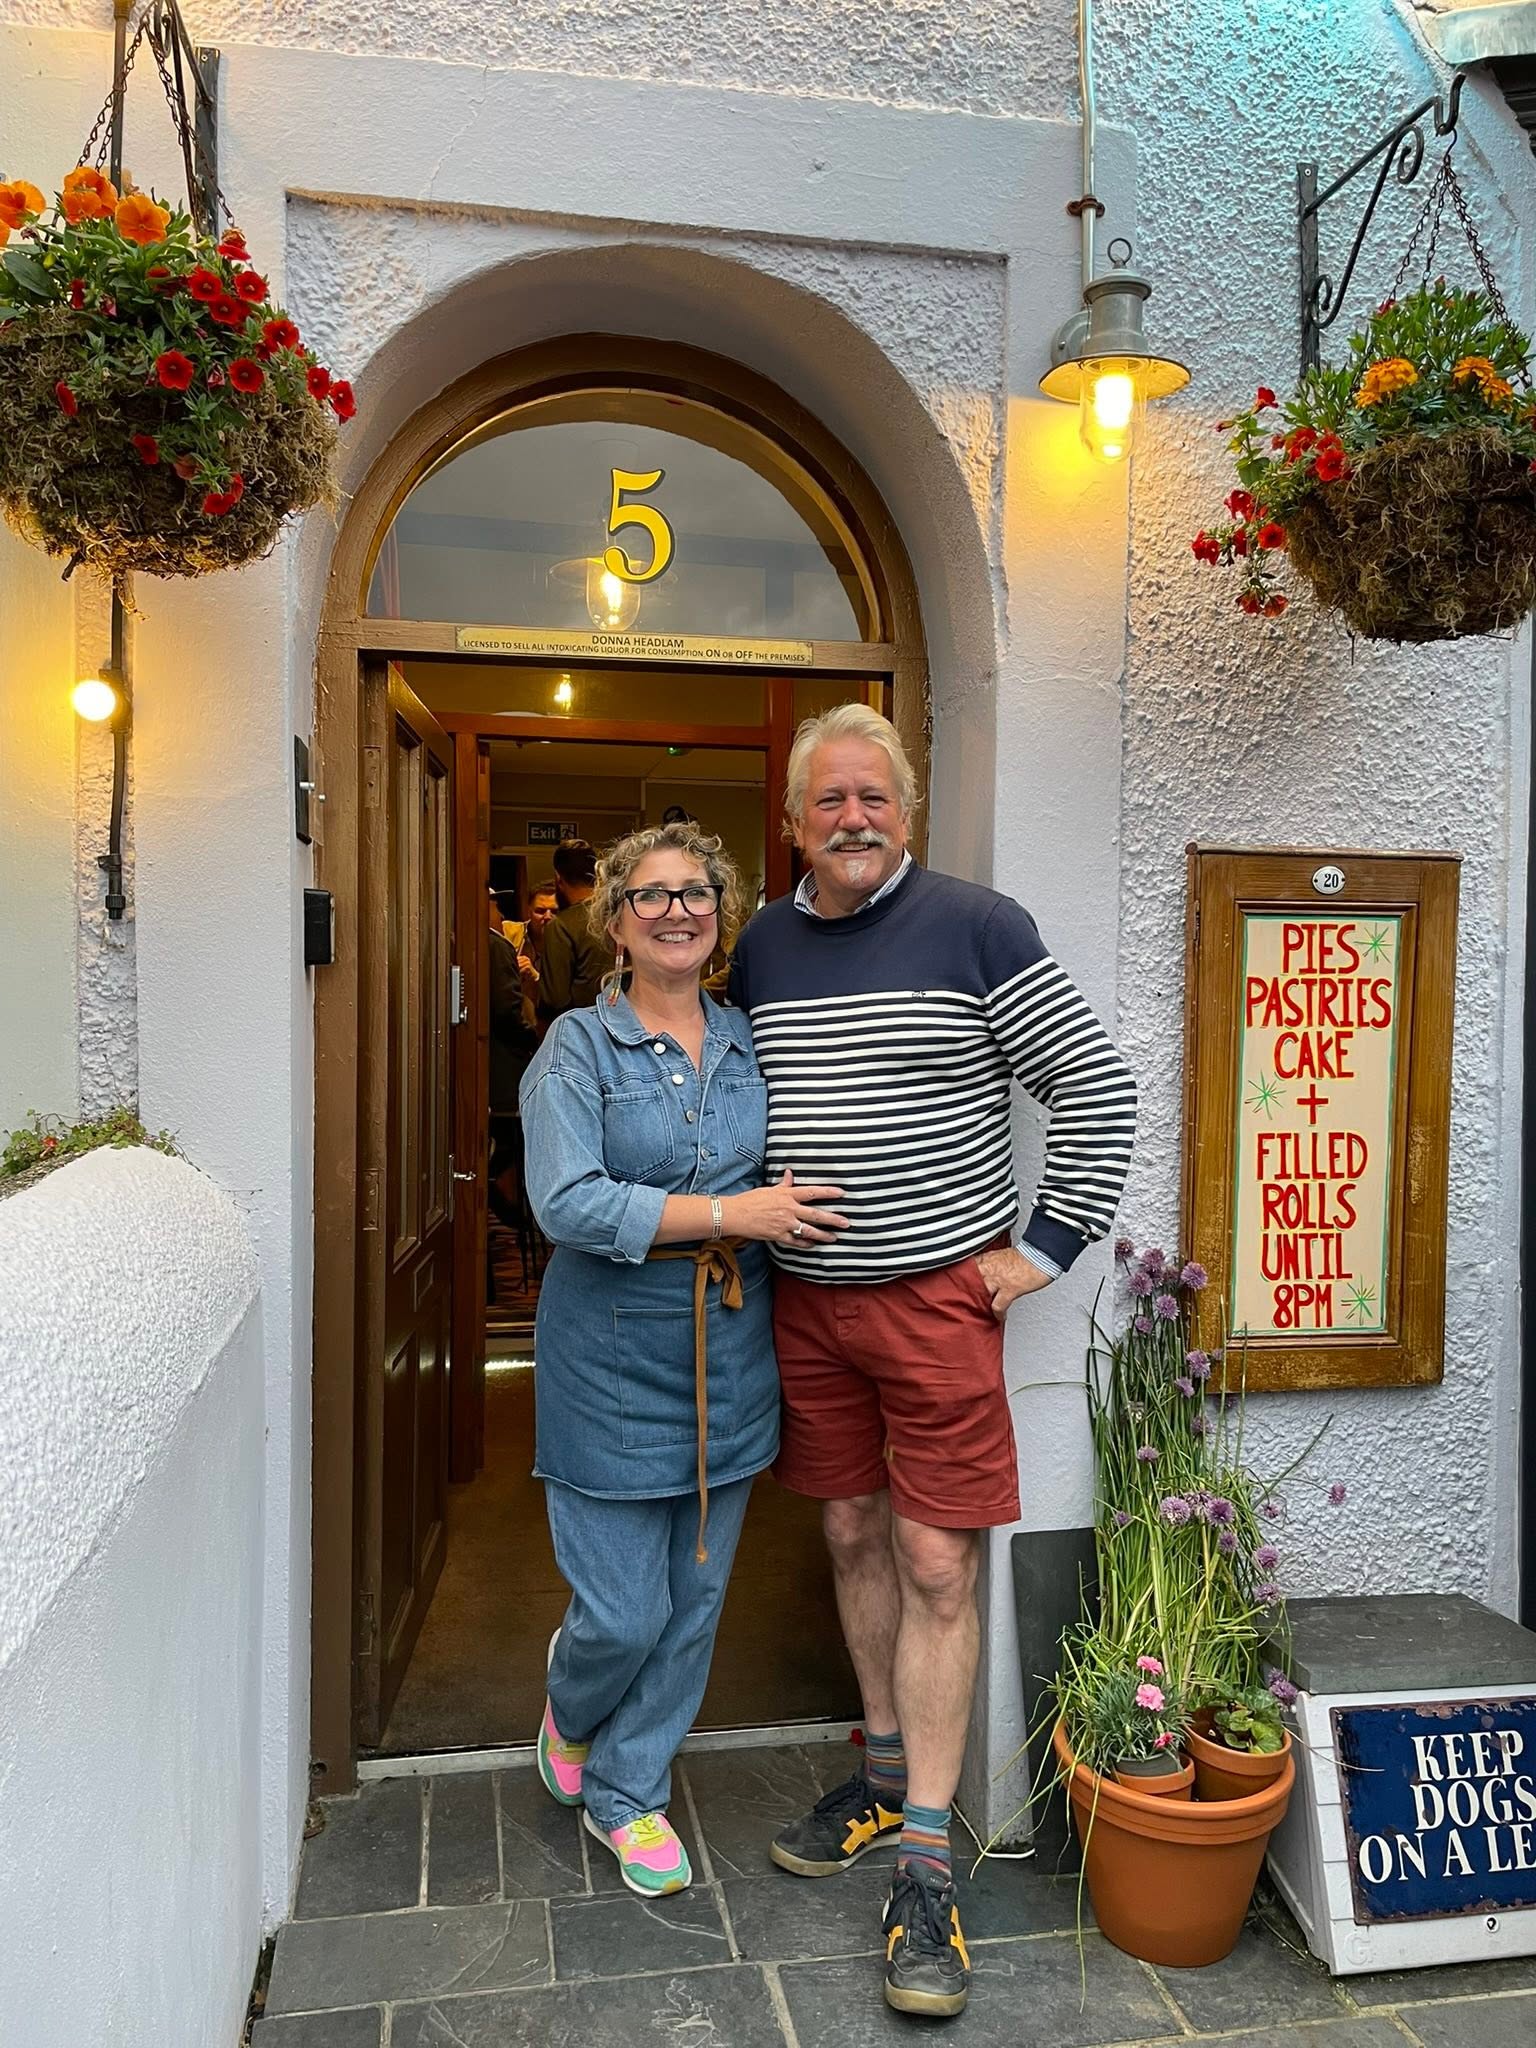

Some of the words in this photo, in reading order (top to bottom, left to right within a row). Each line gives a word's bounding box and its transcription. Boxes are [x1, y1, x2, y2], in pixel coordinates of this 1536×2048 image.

[604, 468, 675, 584] 5
[463, 640, 500, 649] LICENSED
[513, 642, 531, 650] SELL
[531, 643, 545, 651] ALL
[546, 644, 599, 653] INTOXICATING
[600, 646, 629, 655] LIQUOR
[631, 647, 646, 655] FOR
[647, 647, 704, 657] CONSUMPTION
[705, 648, 721, 658] ON
[735, 650, 753, 659] OFF
[755, 652, 768, 660] THE
[770, 653, 805, 662] PREMISES
[592, 635, 631, 645] DONNA
[633, 637, 684, 648] HEADLAM
[530, 826, 556, 840] Exit
[1323, 873, 1339, 889] 20
[1282, 923, 1360, 975] PIES
[1246, 976, 1392, 1029] PASTRIES
[1273, 1030, 1354, 1079] CAKE
[1296, 1083, 1329, 1125] +
[1257, 1132, 1368, 1180] FILLED
[1262, 1183, 1357, 1230] ROLLS
[1261, 1232, 1352, 1281] UNTIL
[1272, 1283, 1333, 1329] 8PM
[1411, 1730, 1524, 1781] KEEP
[1410, 1775, 1536, 1831] DOGS
[1359, 1832, 1427, 1884] ON
[1443, 1828, 1476, 1877] A
